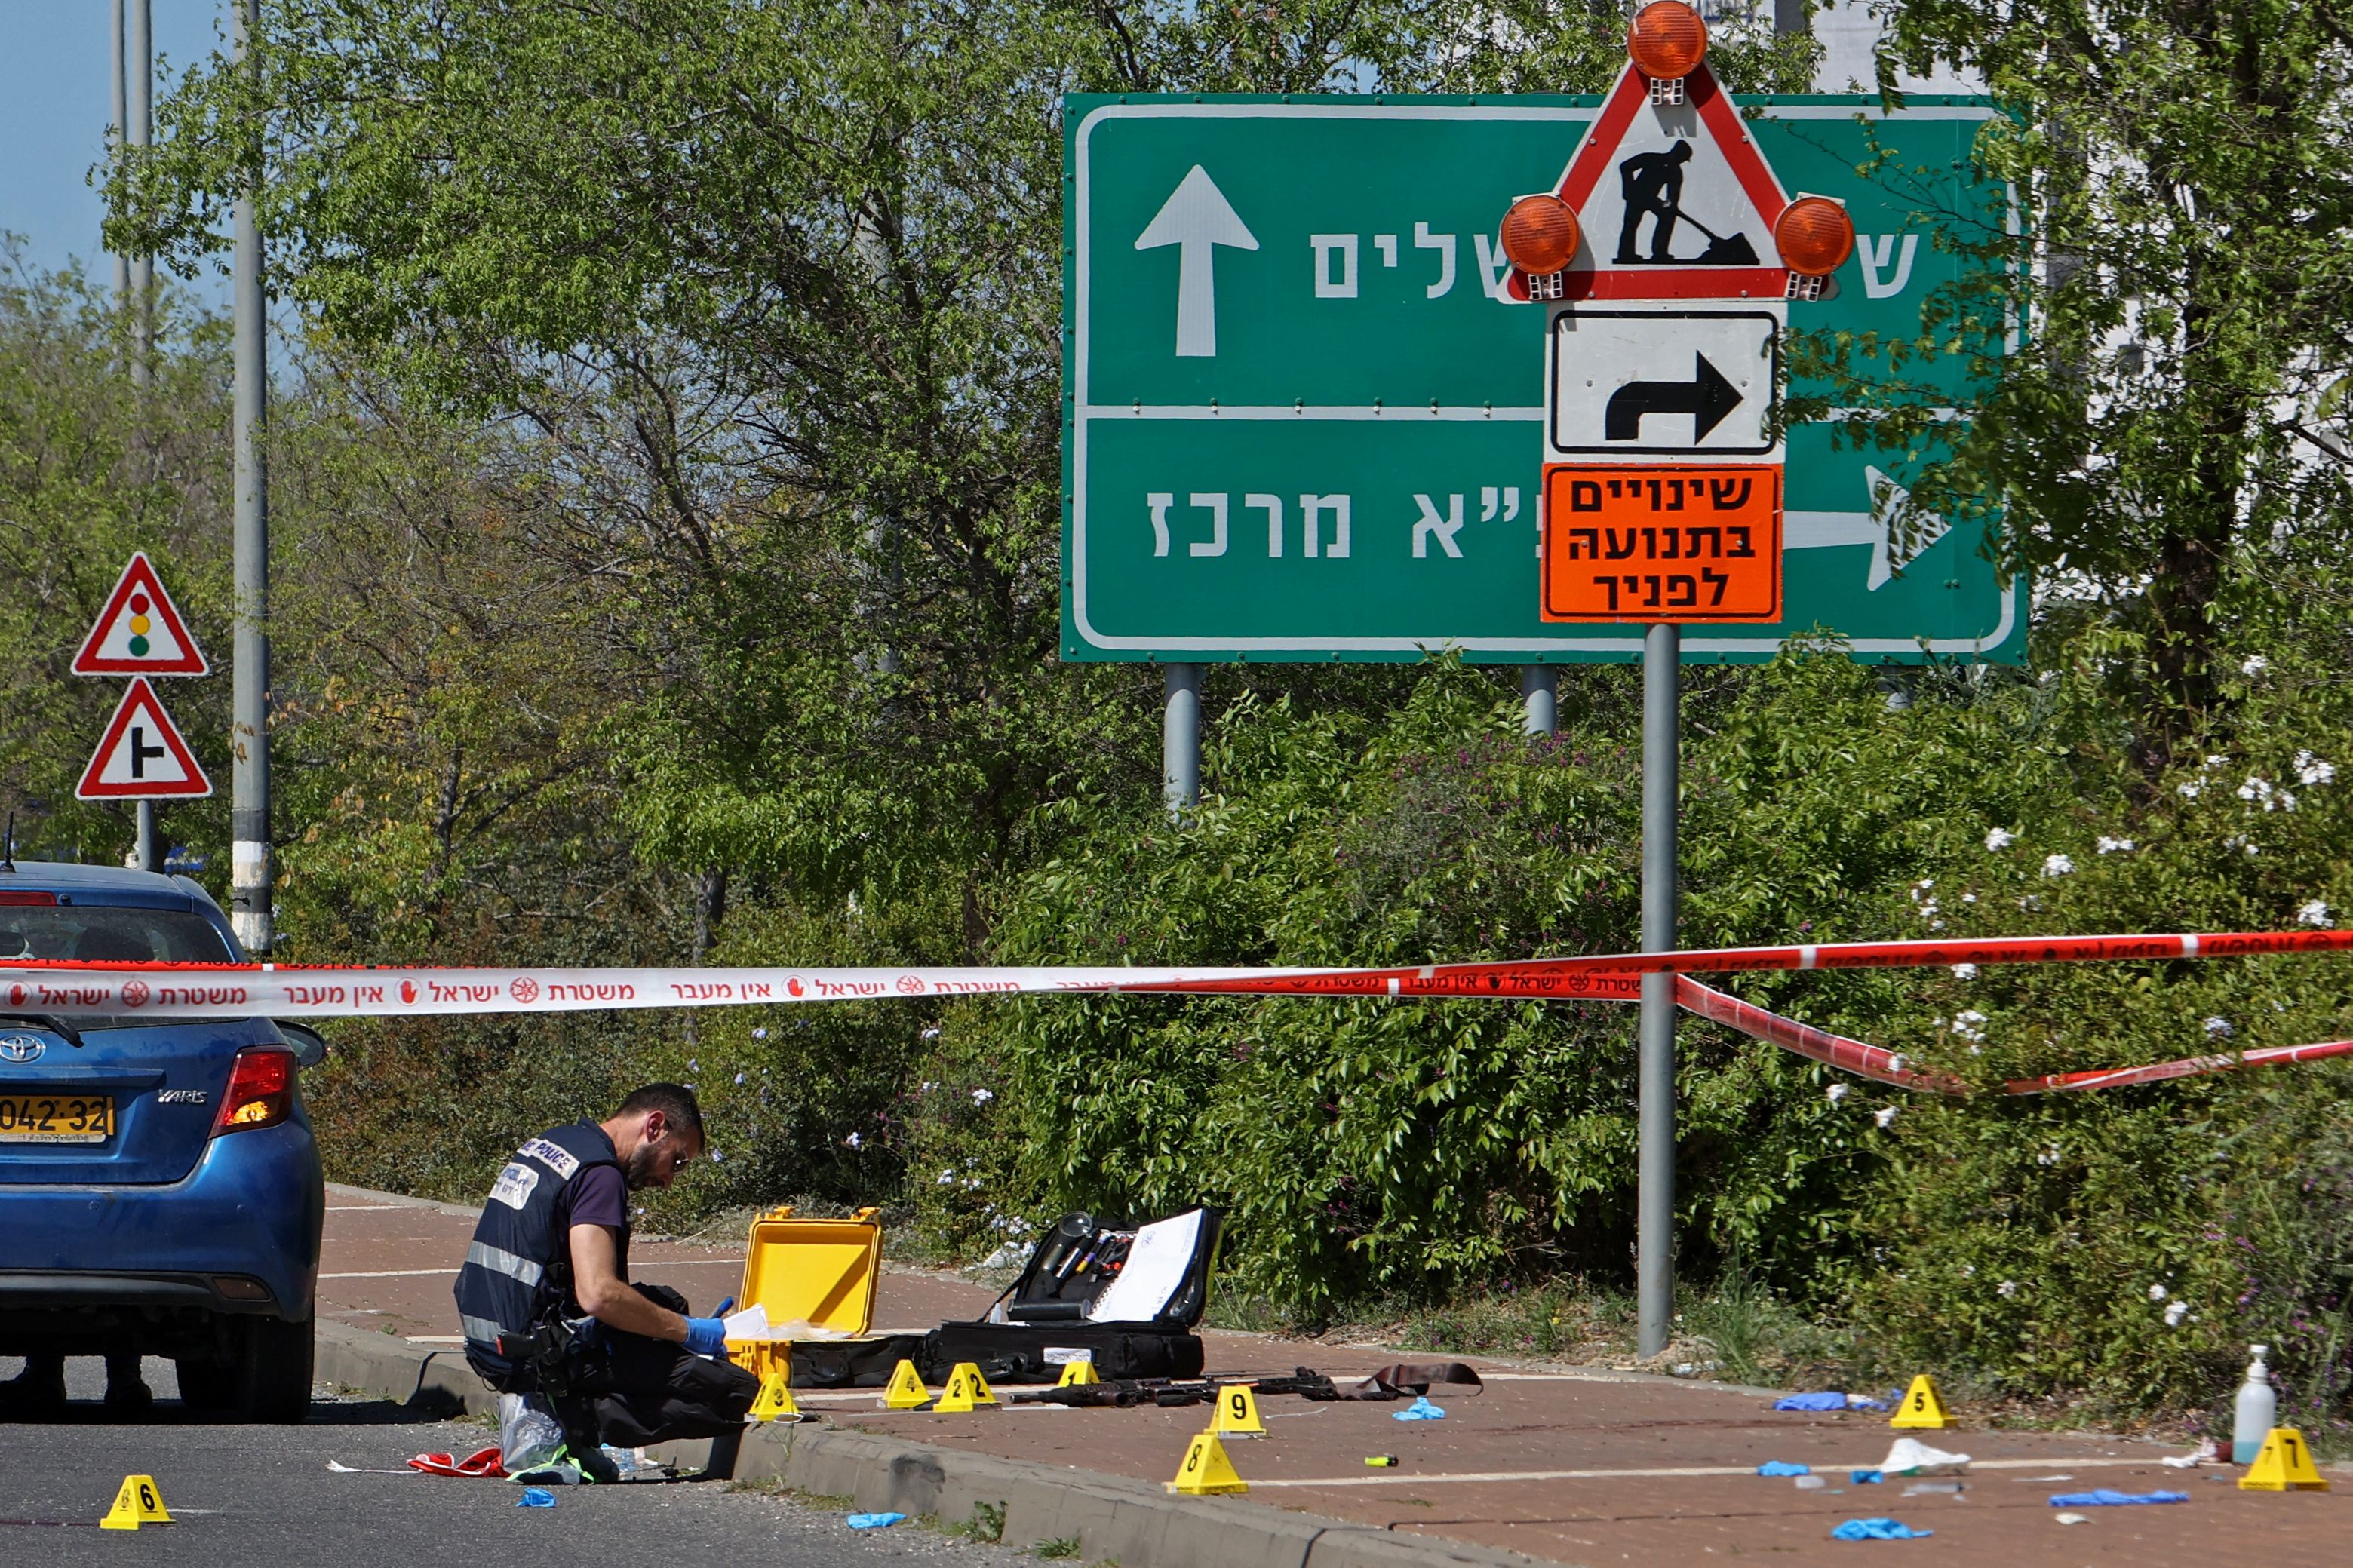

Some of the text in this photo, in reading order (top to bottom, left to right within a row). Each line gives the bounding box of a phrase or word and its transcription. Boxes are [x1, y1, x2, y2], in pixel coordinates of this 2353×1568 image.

[1571, 478, 1752, 513] שינויים
[1147, 492, 1351, 558] מרכז
[1569, 526, 1756, 560] בתנועה
[1593, 567, 1729, 611] לפניך
[38, 985, 110, 1004] ישראל
[158, 987, 247, 1005] משטרת
[283, 987, 345, 1005] מעבר
[354, 986, 384, 1008] אין
[428, 981, 499, 1002] ישראל
[548, 983, 635, 1001] משטרת
[671, 984, 732, 999] מעבר
[741, 983, 772, 1000] אין
[815, 979, 885, 995] ישראל
[535, 1143, 571, 1169] POLICE
[952, 1379, 961, 1398] 2
[969, 1373, 986, 1398] 2
[1231, 1394, 1247, 1420] 9
[1914, 1392, 1925, 1413] 5
[1187, 1444, 1203, 1473] 8
[2284, 1438, 2299, 1469] 7
[140, 1484, 155, 1511] 6
